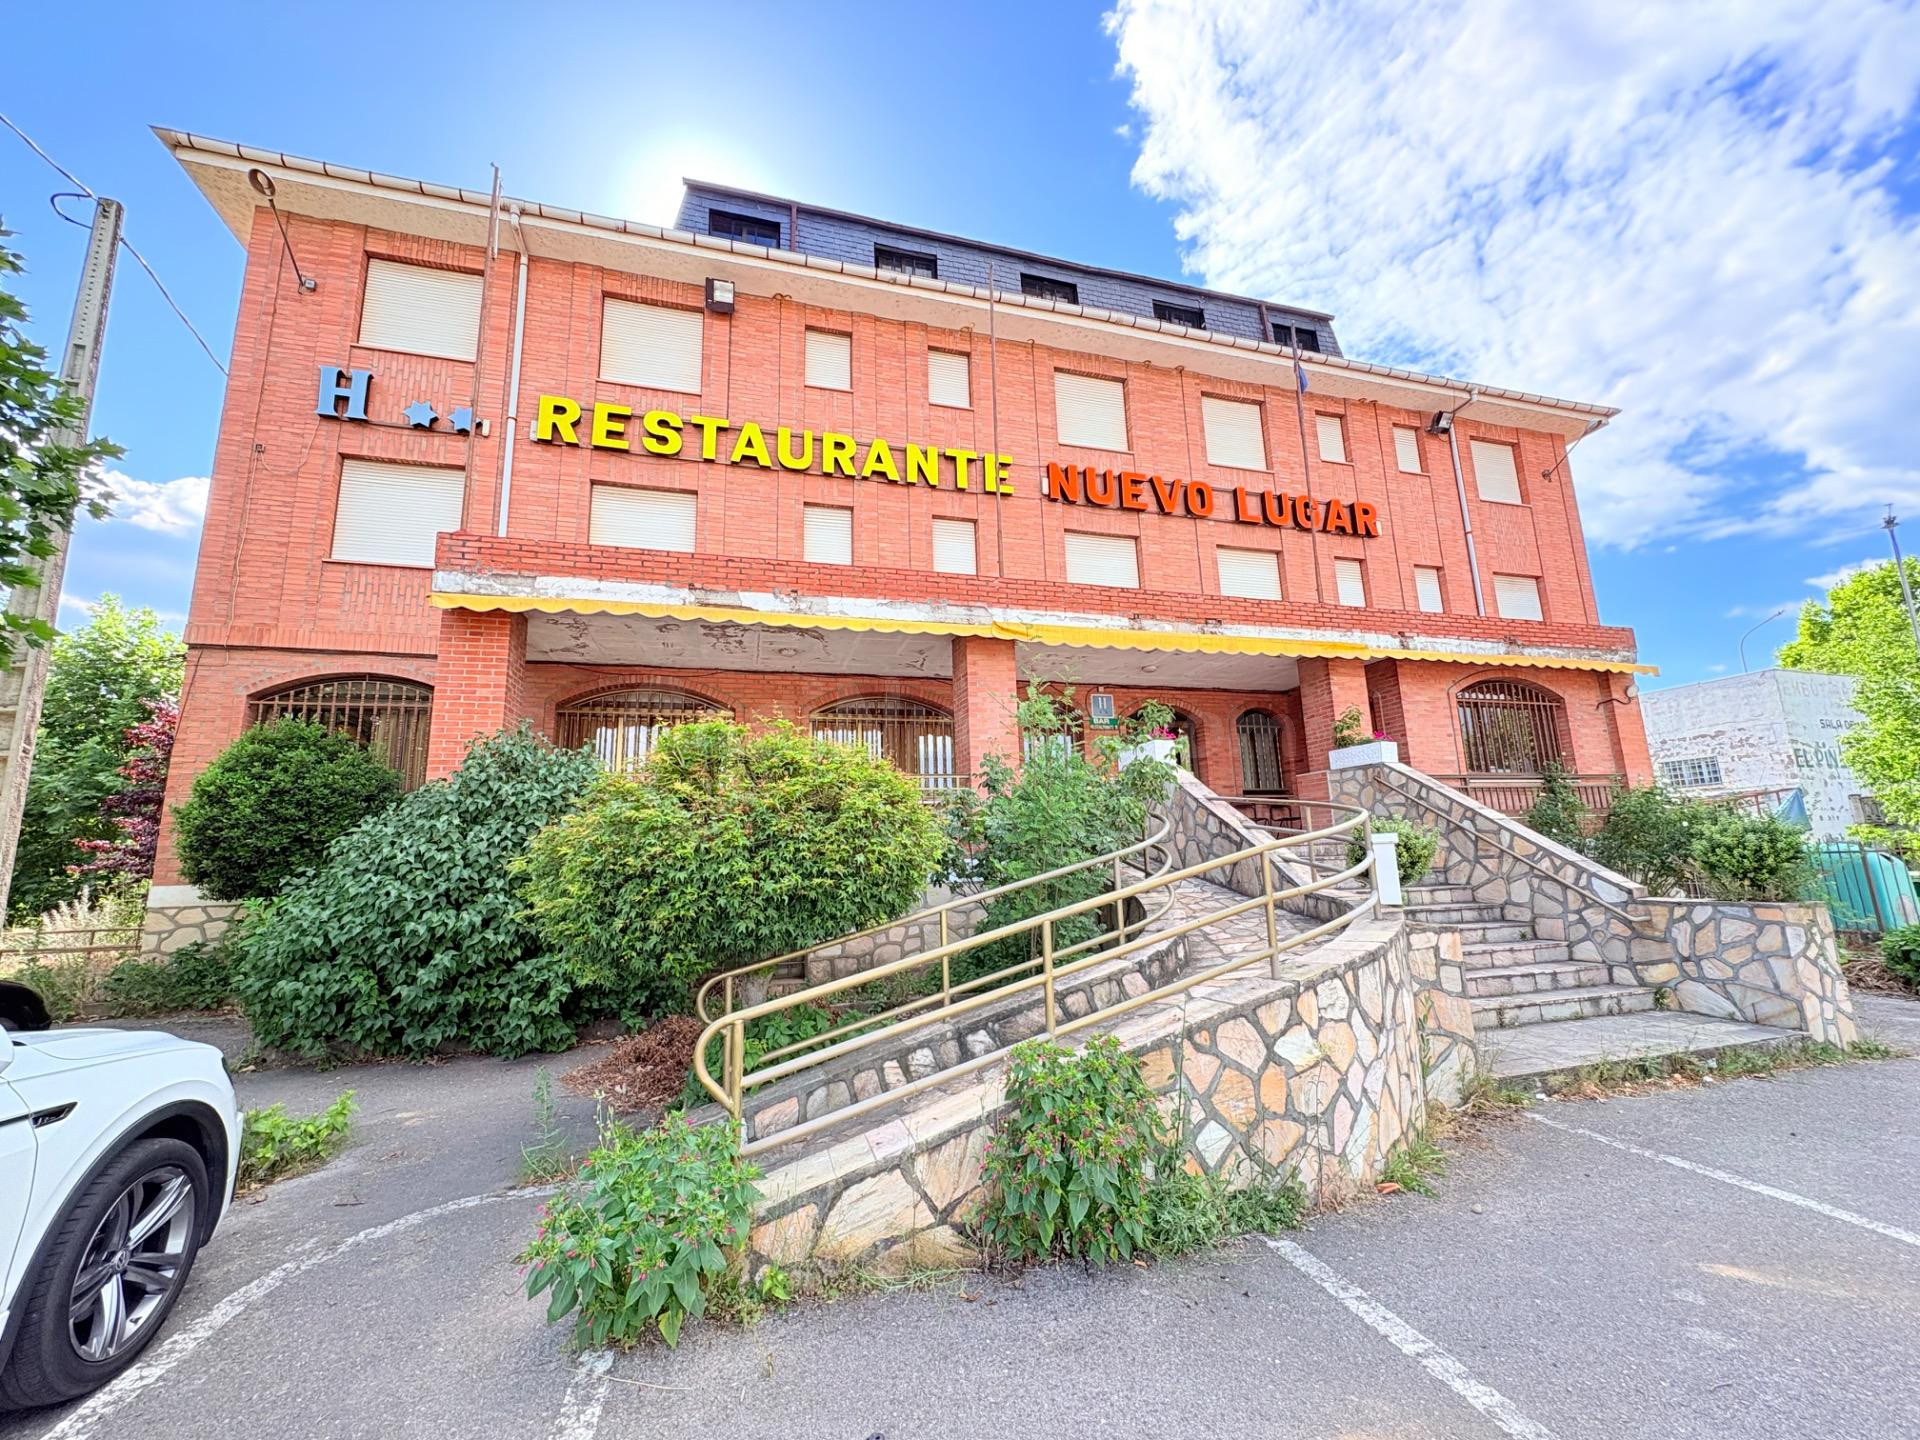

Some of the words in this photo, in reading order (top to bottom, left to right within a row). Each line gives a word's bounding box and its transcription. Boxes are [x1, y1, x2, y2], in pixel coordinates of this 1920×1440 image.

[315, 365, 373, 420] H
[536, 394, 1015, 495] RESTAURANTE
[1047, 462, 1214, 518] NUEVO
[1233, 486, 1379, 538] LUGAR
[1819, 718, 1843, 730] SALA
[1793, 748, 1815, 769] EL
